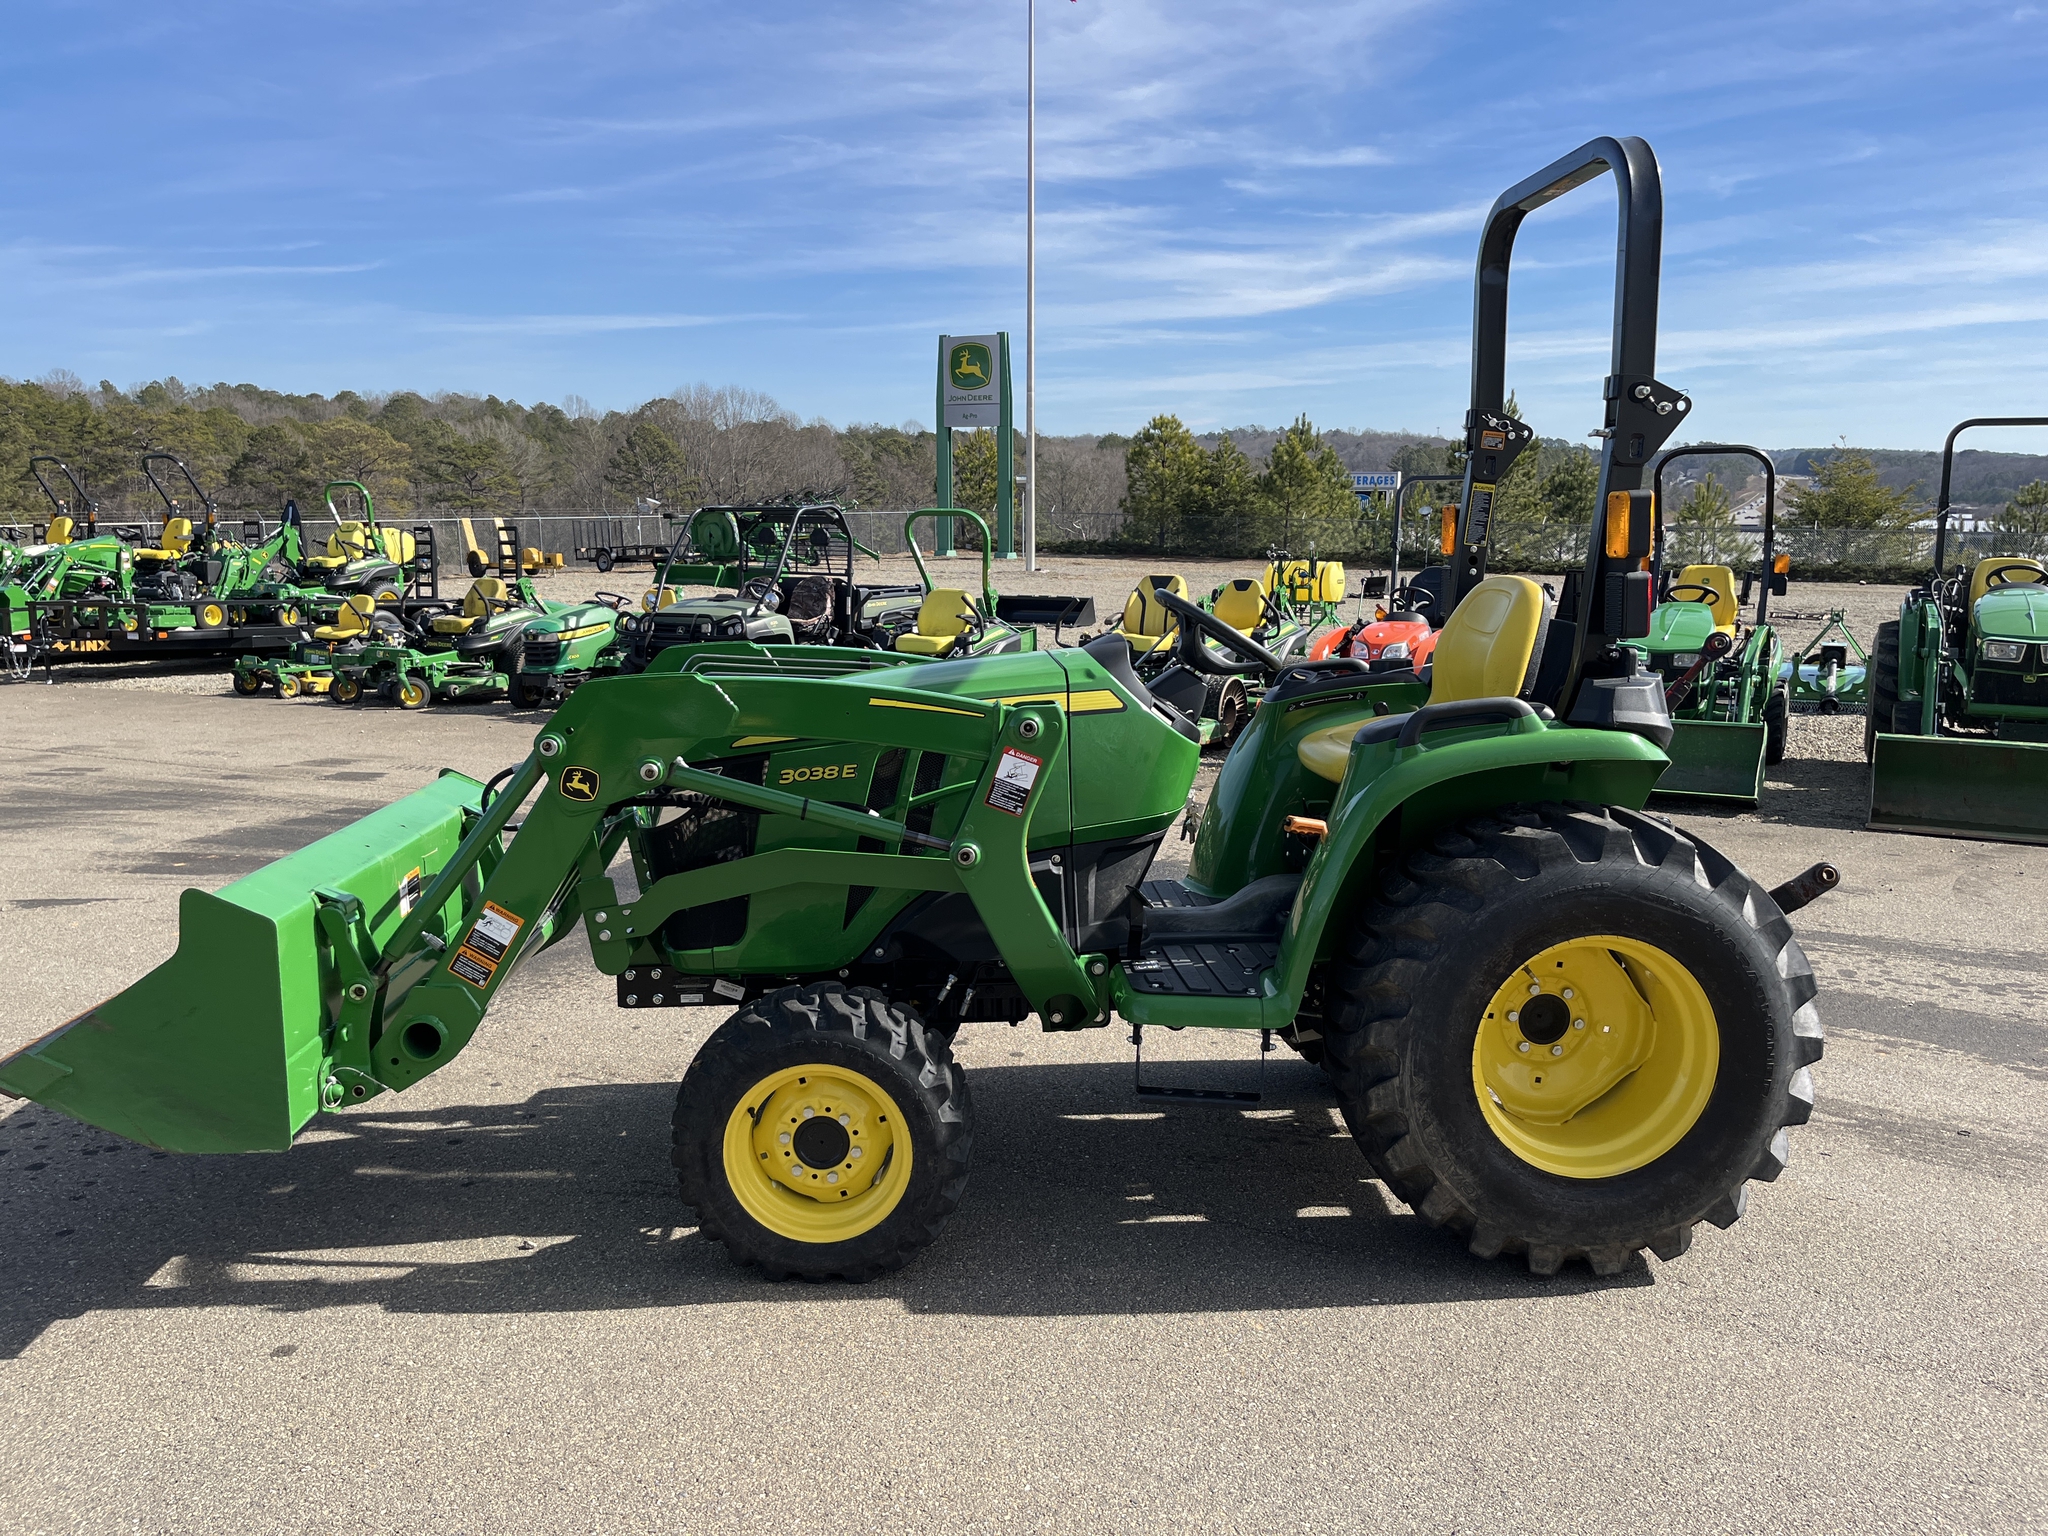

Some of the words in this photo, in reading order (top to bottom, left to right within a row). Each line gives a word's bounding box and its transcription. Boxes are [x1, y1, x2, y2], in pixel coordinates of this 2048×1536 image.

[948, 394, 967, 402] JOHN
[967, 393, 993, 401] DEERE
[962, 412, 978, 420] Ag-Pro
[1344, 475, 1395, 486] ERAGES
[70, 639, 112, 652] LINX
[1015, 751, 1038, 763] DANGER
[495, 908, 519, 923] WARNING
[469, 953, 493, 968] WARNING
